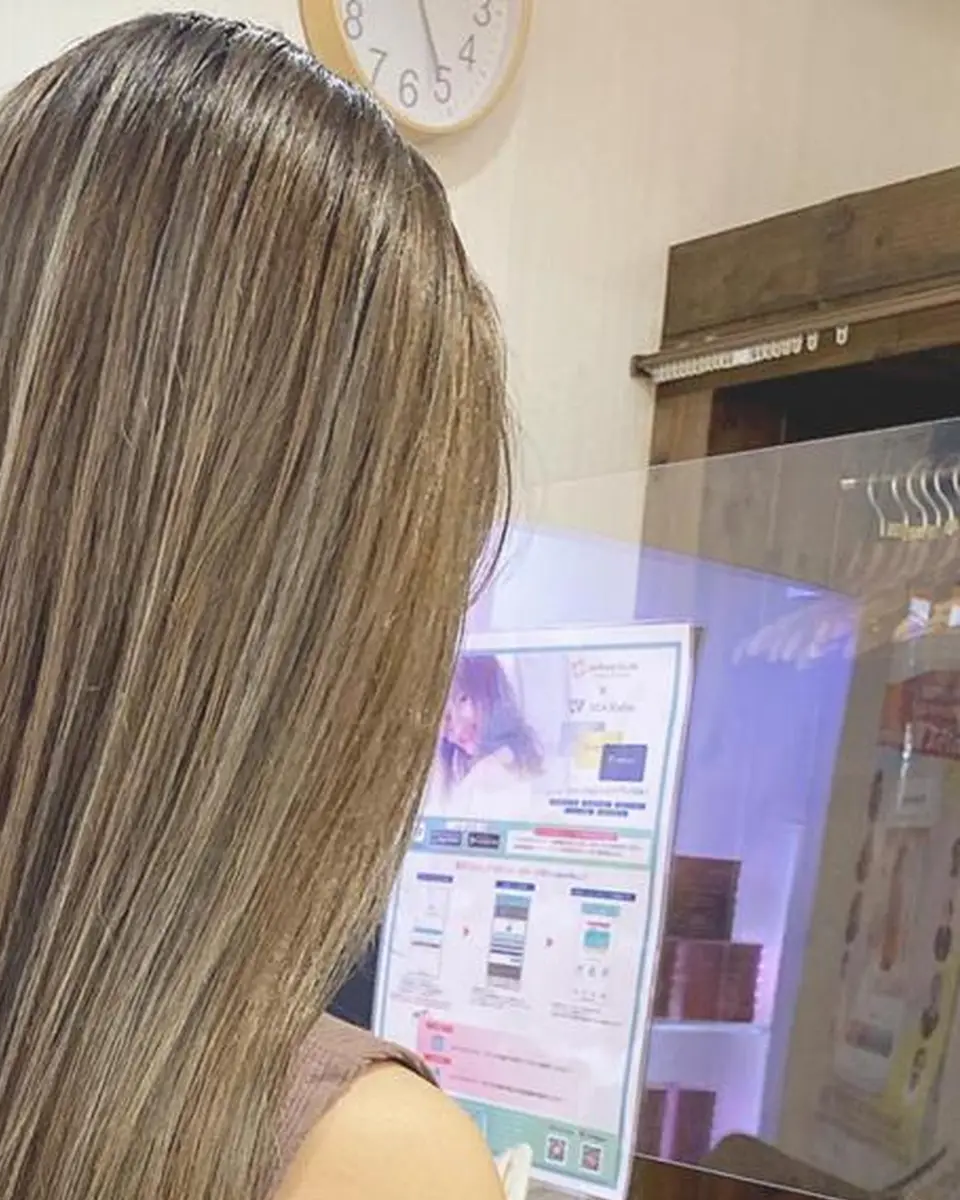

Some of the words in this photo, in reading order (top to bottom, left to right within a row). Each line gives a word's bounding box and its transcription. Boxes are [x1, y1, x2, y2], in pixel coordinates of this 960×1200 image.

[369, 47, 388, 85] 7
[458, 34, 477, 70] 4
[398, 68, 419, 108] 6
[433, 64, 452, 105] 5
